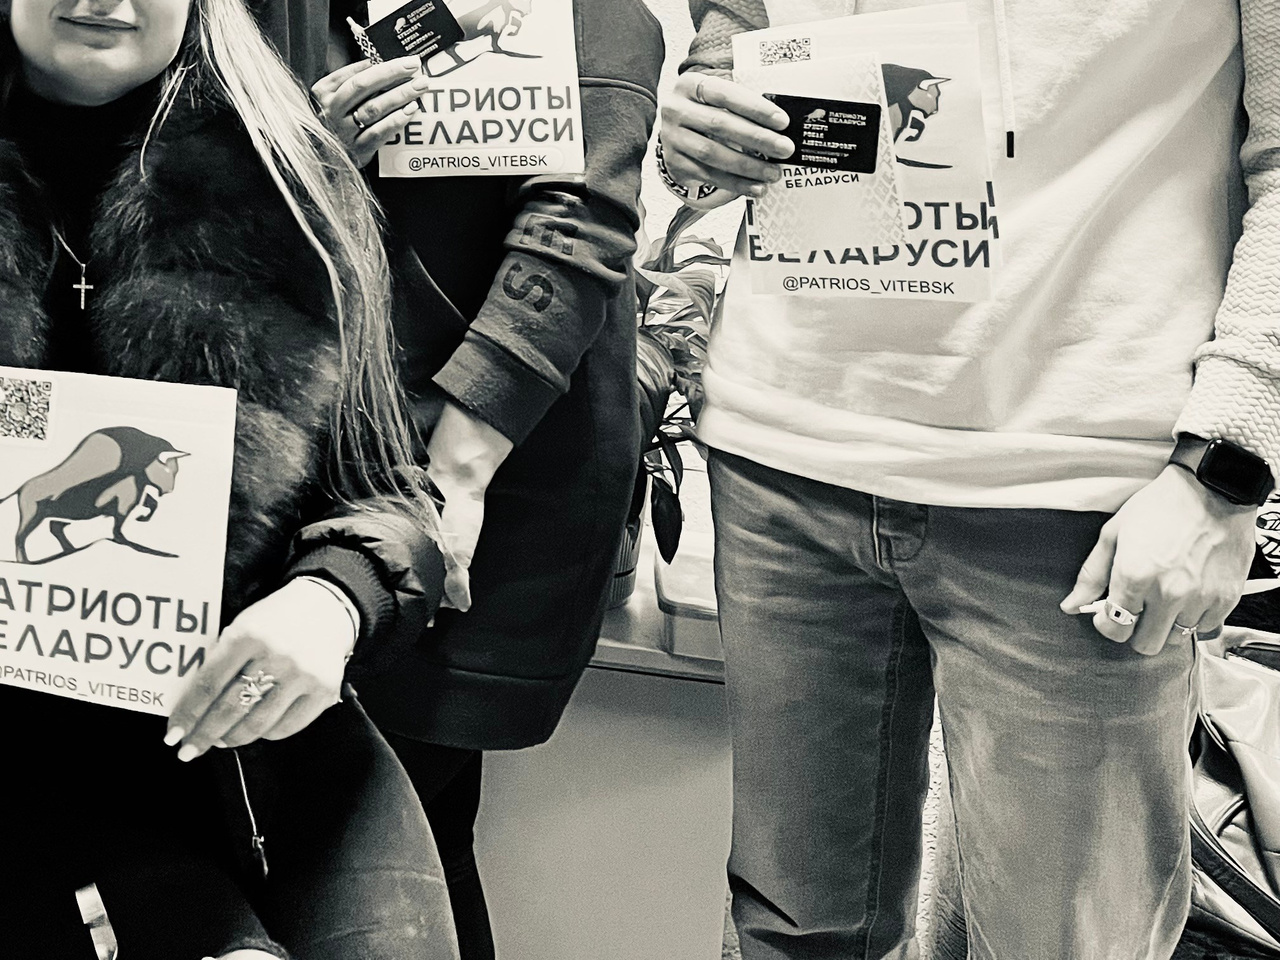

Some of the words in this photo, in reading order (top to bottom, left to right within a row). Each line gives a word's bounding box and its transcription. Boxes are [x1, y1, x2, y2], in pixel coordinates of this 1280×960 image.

[408, 155, 547, 171] @PATRIOS_VITEBSK
[785, 173, 860, 189] БЕЛАРУСИ
[782, 276, 955, 295] @PATRIOS_VITEBSK
